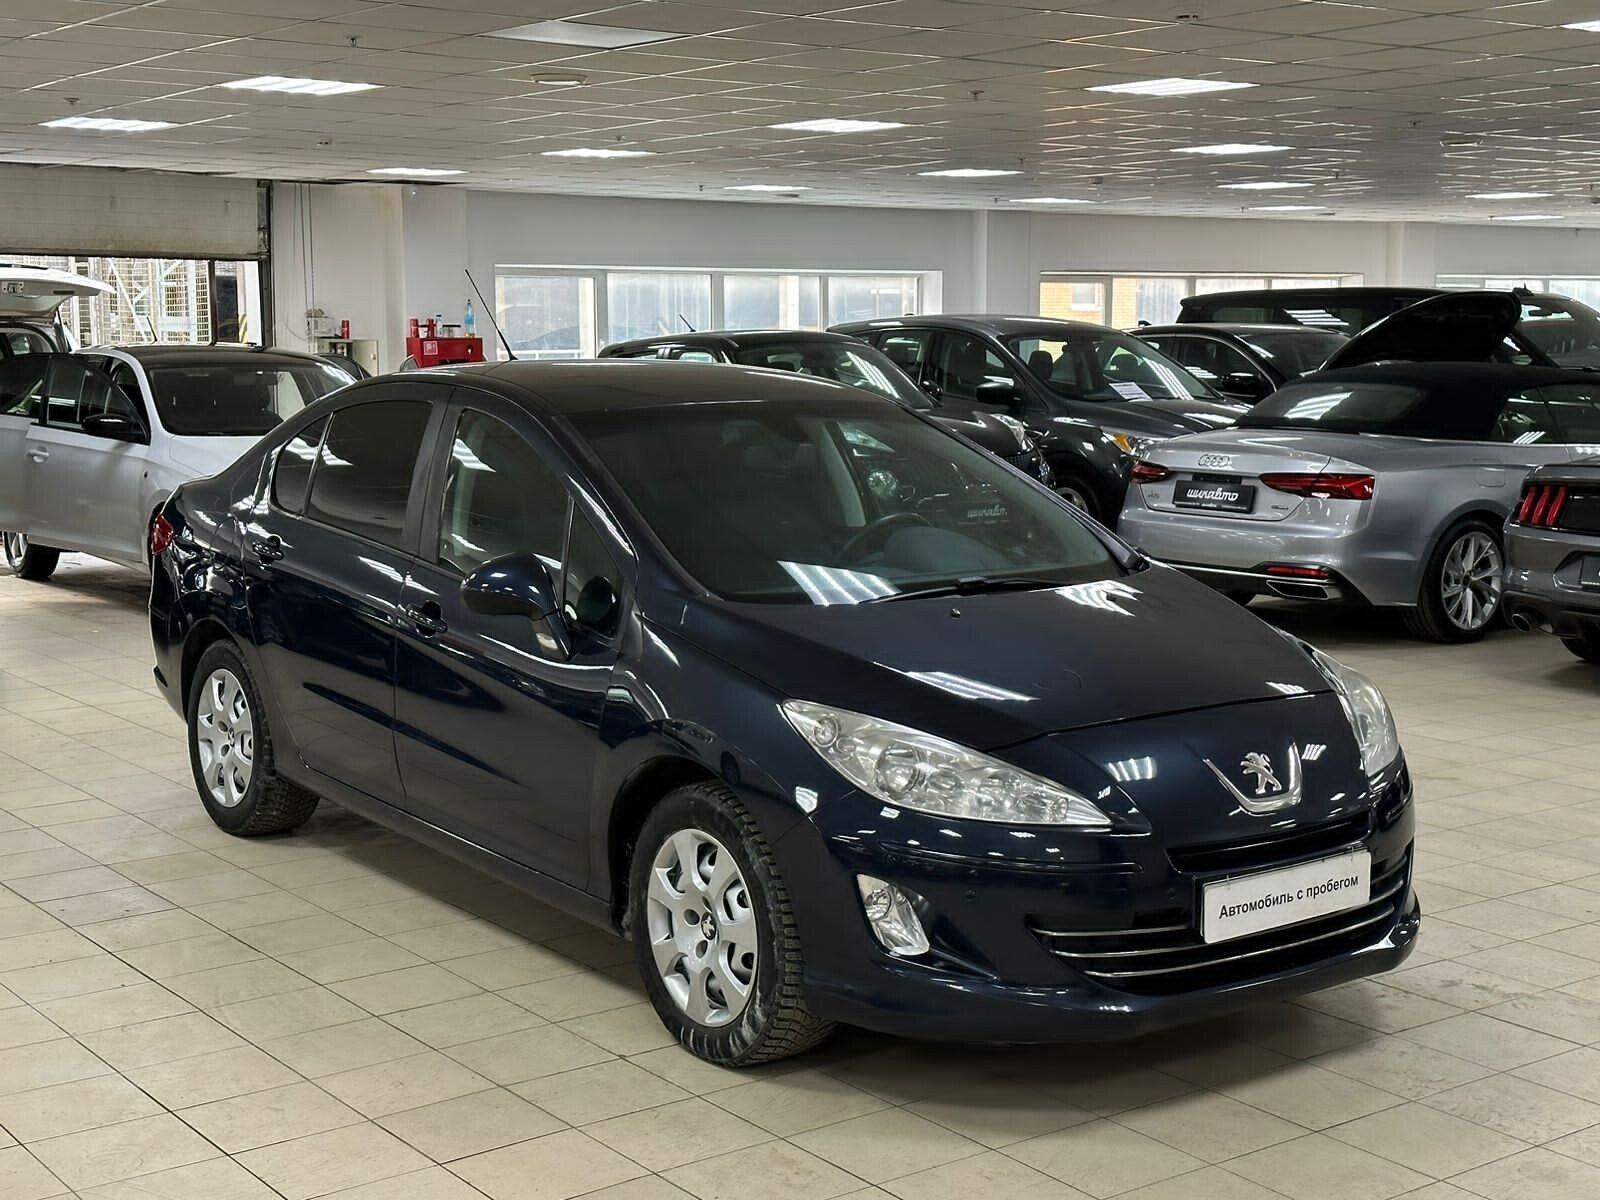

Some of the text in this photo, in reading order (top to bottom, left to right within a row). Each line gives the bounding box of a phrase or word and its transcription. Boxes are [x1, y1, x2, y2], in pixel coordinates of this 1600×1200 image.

[1219, 875, 1359, 919] Автомобиль с пробегом
